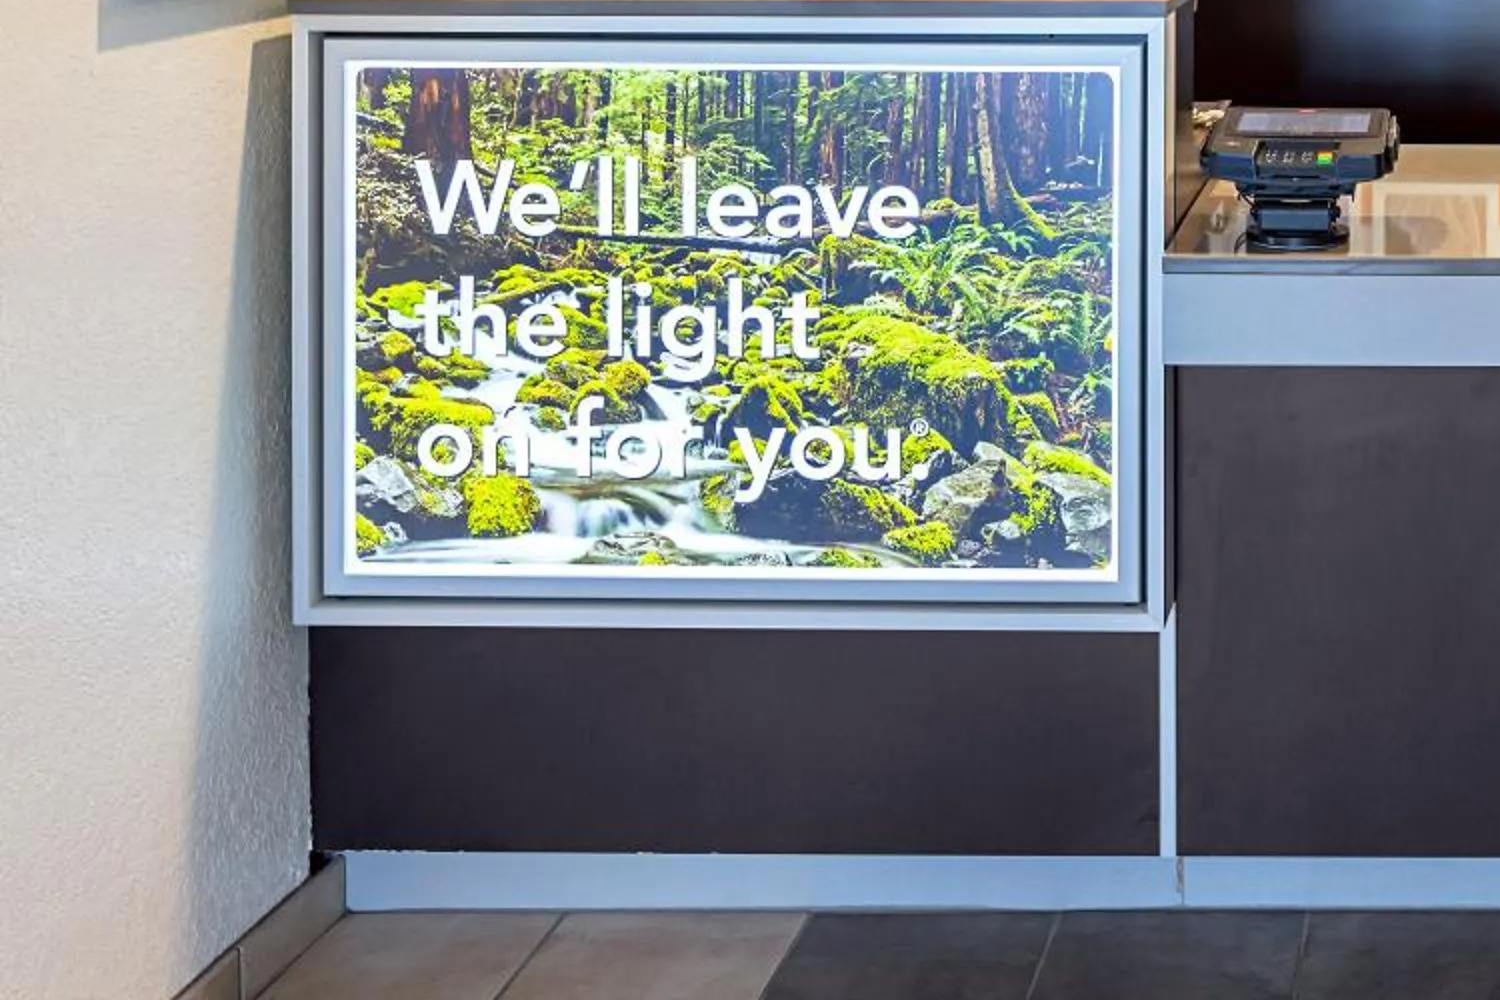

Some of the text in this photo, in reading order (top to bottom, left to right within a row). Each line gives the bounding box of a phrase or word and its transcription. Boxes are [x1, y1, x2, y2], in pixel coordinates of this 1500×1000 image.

[415, 156, 922, 239] We'll leave
[415, 277, 822, 382] the light
[417, 421, 531, 480] on
[570, 396, 698, 480] for
